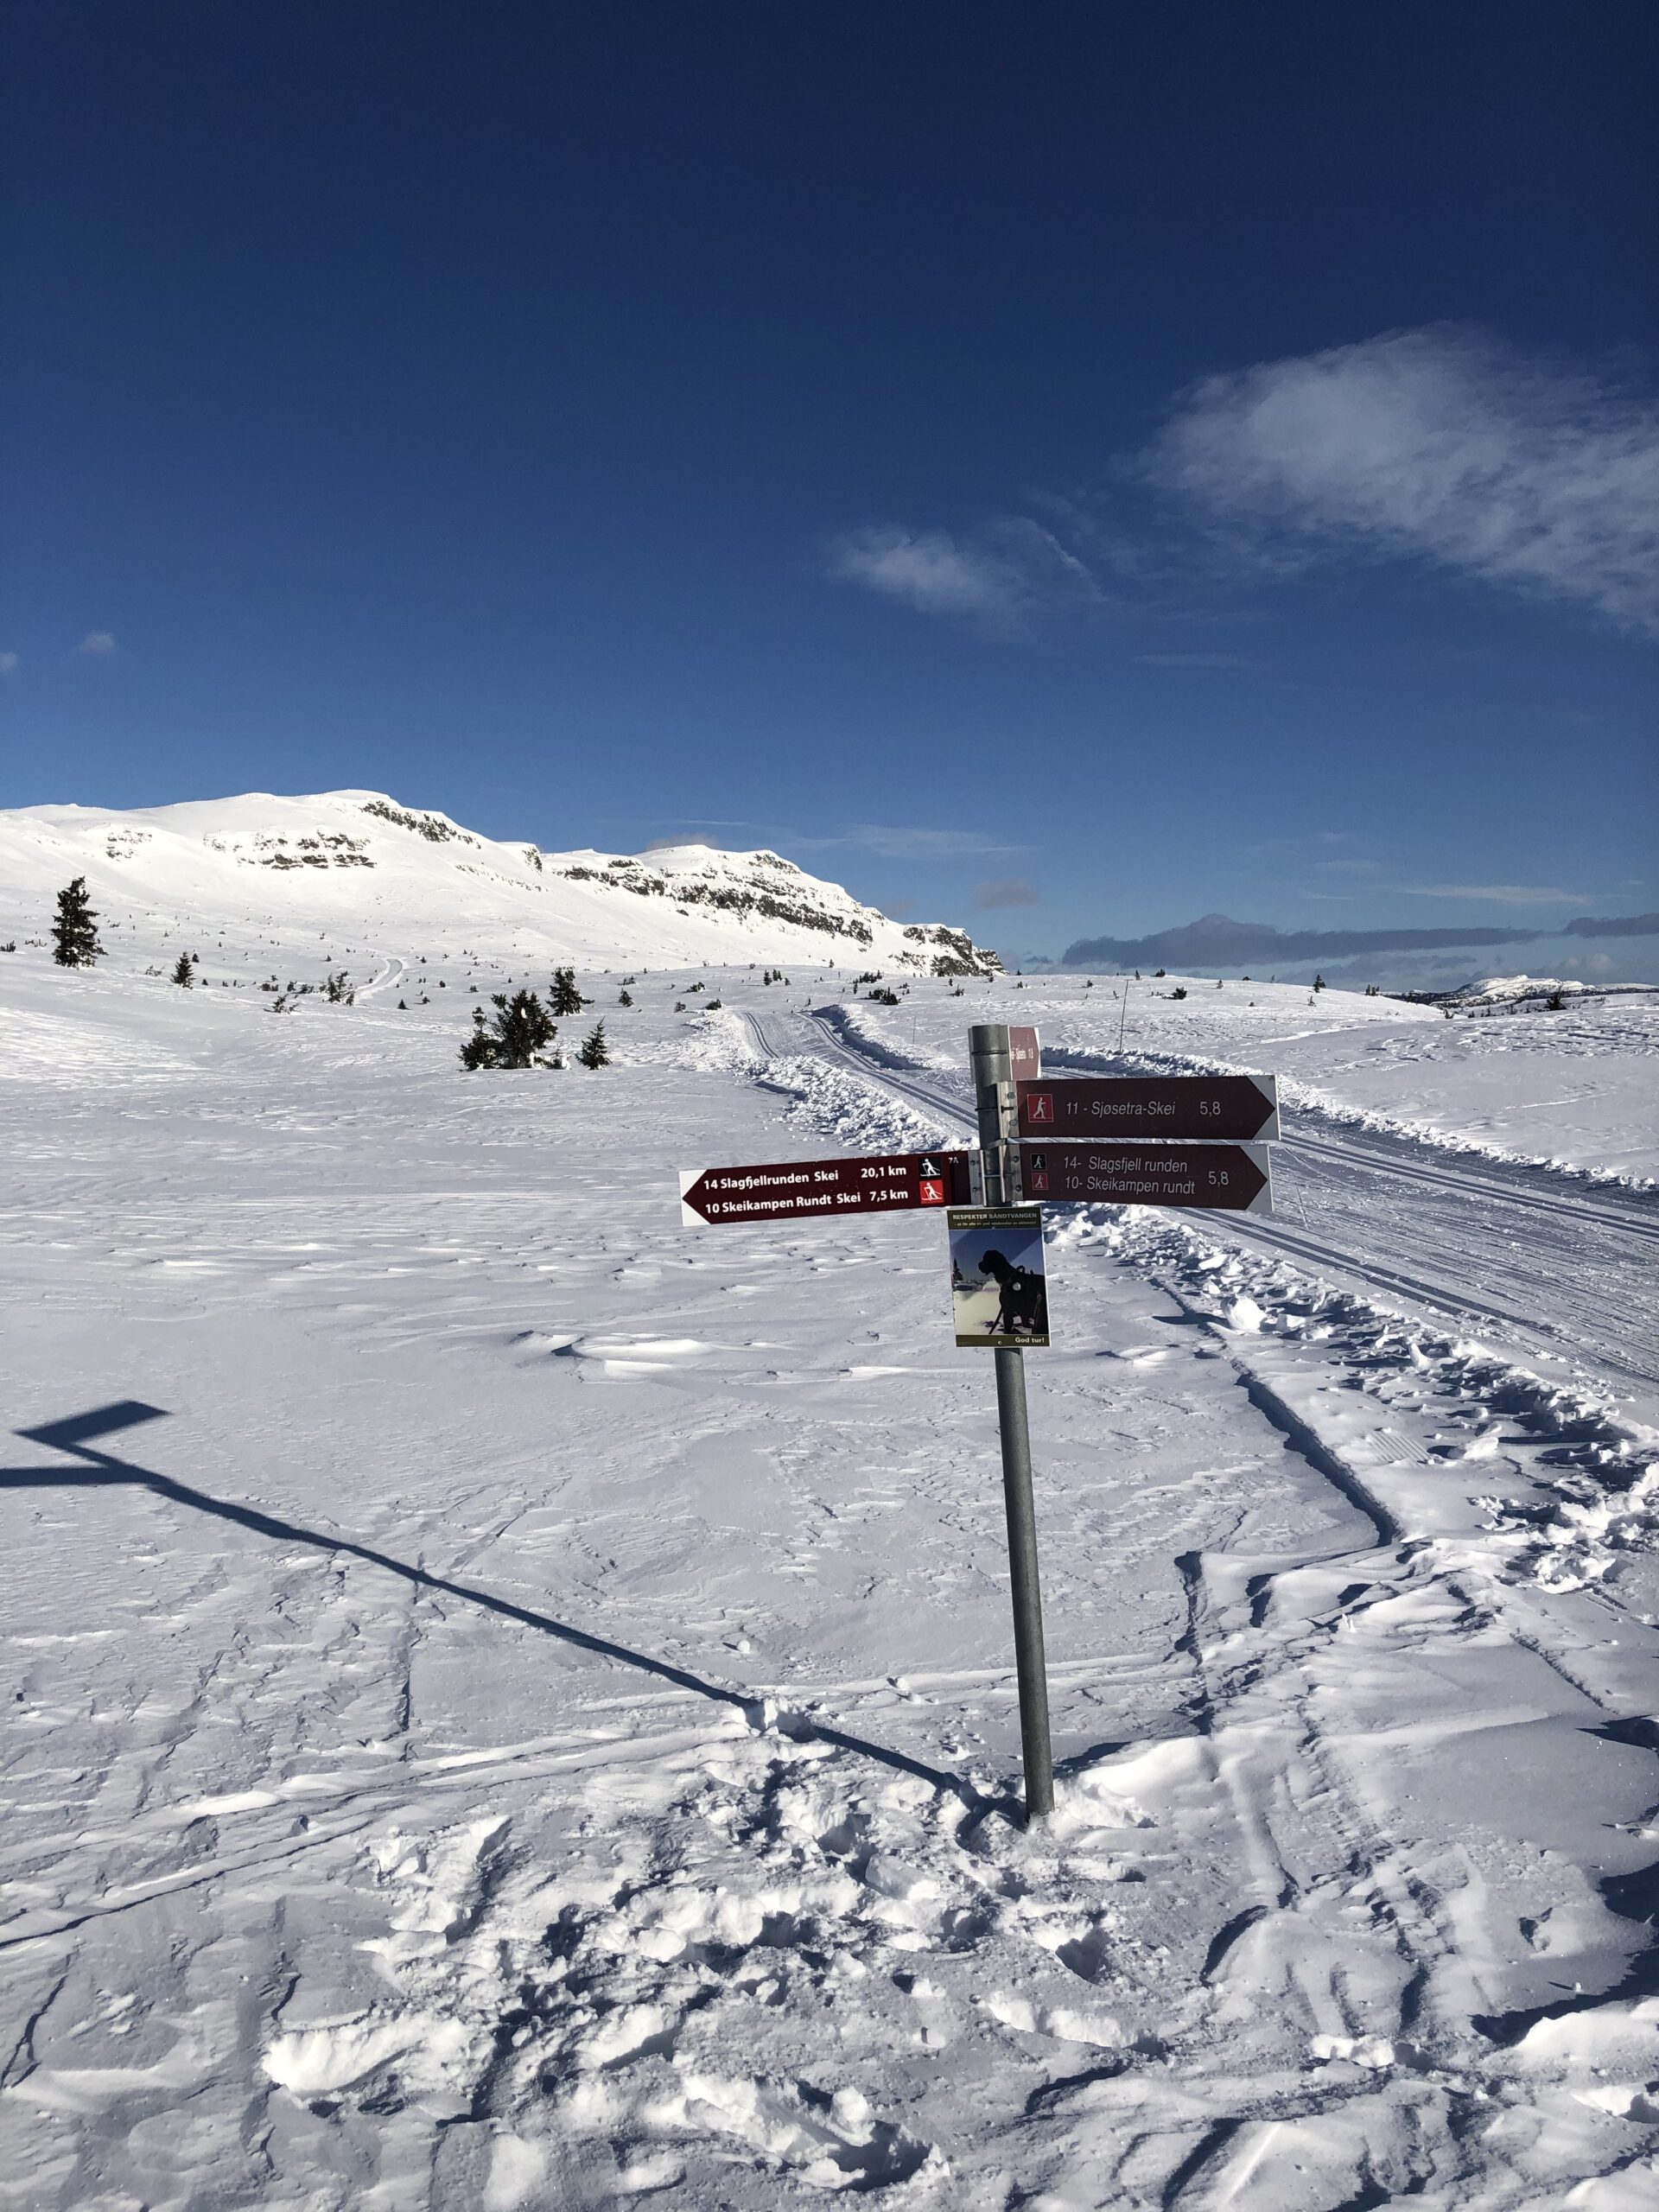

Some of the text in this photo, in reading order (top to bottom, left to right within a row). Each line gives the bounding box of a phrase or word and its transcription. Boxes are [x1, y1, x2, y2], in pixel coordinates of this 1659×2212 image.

[1066, 1103, 1078, 1115] 11
[1091, 1101, 1175, 1117] Sjøsetra-Skei
[1199, 1102, 1221, 1116] 5,8
[1064, 1156, 1188, 1173] 14- Slagsfjell runden
[703, 1166, 907, 1190] 14 Slagfjellrunden Skei 20,1 km
[1065, 1176, 1195, 1194] 10- Skeikampen rundt
[1208, 1171, 1229, 1186] 5,8
[705, 1190, 908, 1214] 10 Skeikampen Rundt Skei 7,5 km
